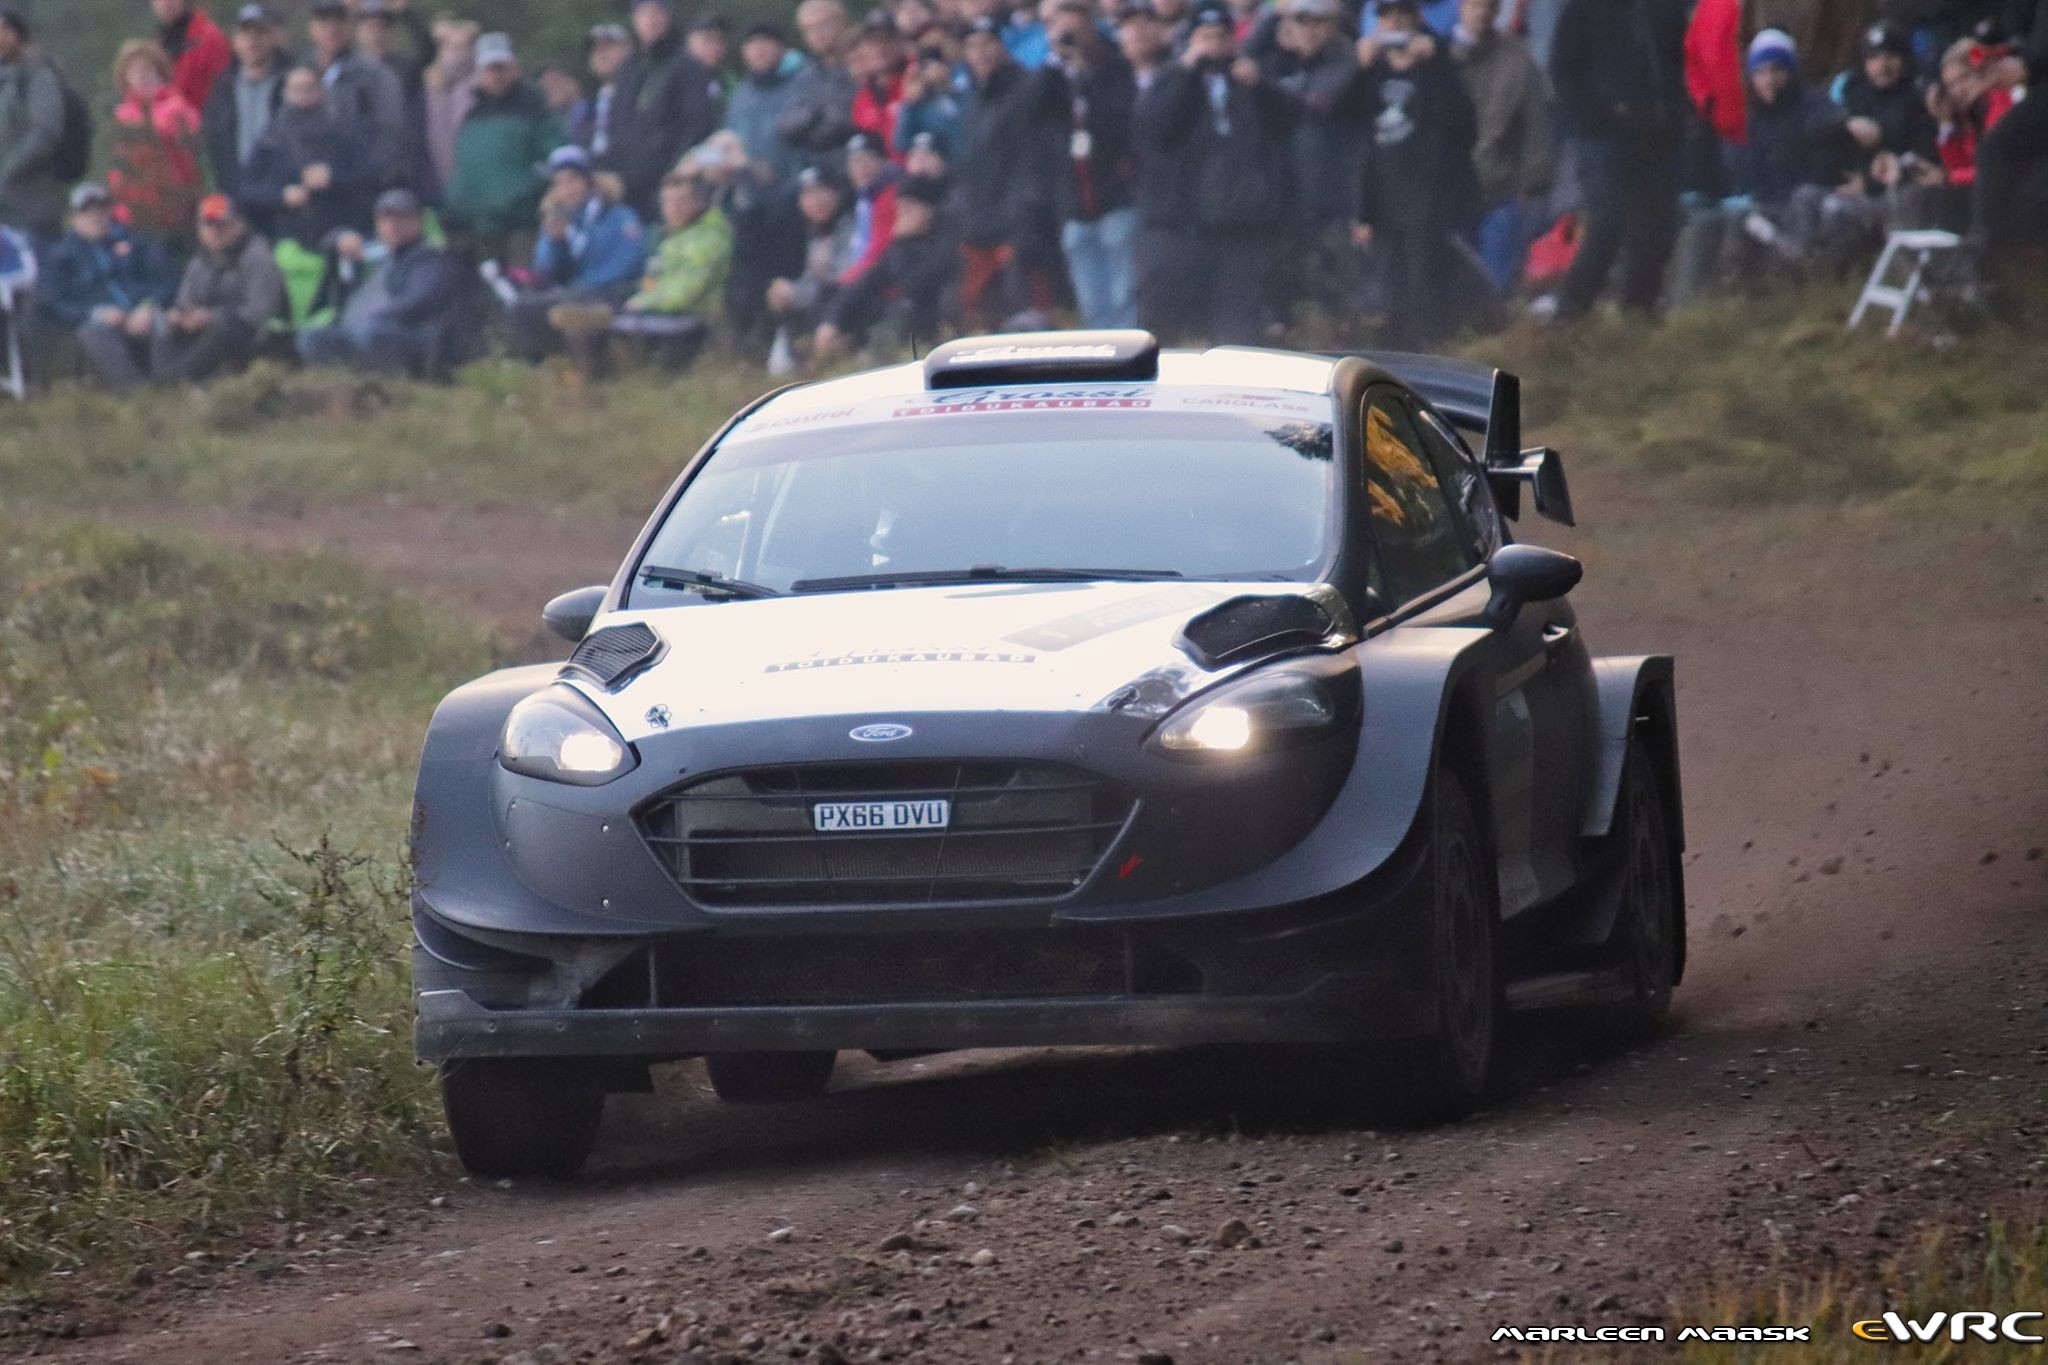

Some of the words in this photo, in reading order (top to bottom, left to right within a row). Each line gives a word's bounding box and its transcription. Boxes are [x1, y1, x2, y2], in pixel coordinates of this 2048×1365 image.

[898, 399, 1149, 416] TOIDUKAUBAD
[1182, 398, 1310, 412] CARGLASS
[777, 653, 1027, 671] TOIDUKAUBAD
[863, 727, 898, 738] Ford
[820, 805, 884, 828] PX66
[893, 803, 943, 826] DVU
